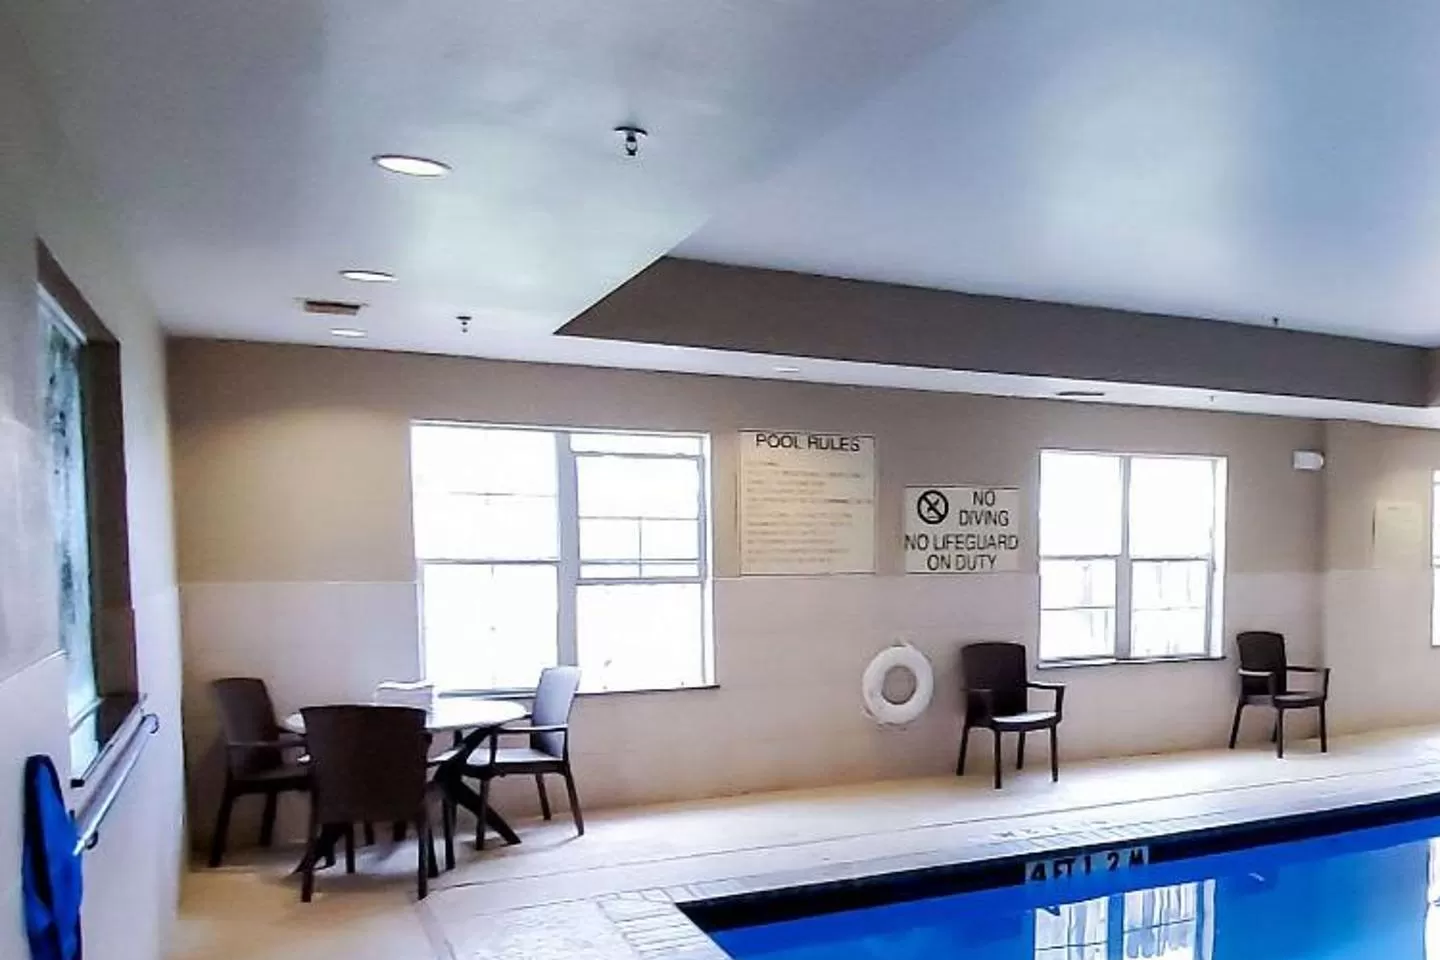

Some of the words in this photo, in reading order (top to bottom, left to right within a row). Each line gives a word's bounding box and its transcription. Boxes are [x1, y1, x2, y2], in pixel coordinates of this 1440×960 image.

[755, 433, 805, 450] POOL
[808, 436, 861, 452] RULES
[973, 490, 996, 507] NO
[959, 509, 1010, 527] DIVING
[905, 533, 929, 551] NO
[932, 533, 1019, 551] LIFEGUARD
[926, 554, 952, 571] ON
[956, 554, 998, 571] DUTY
